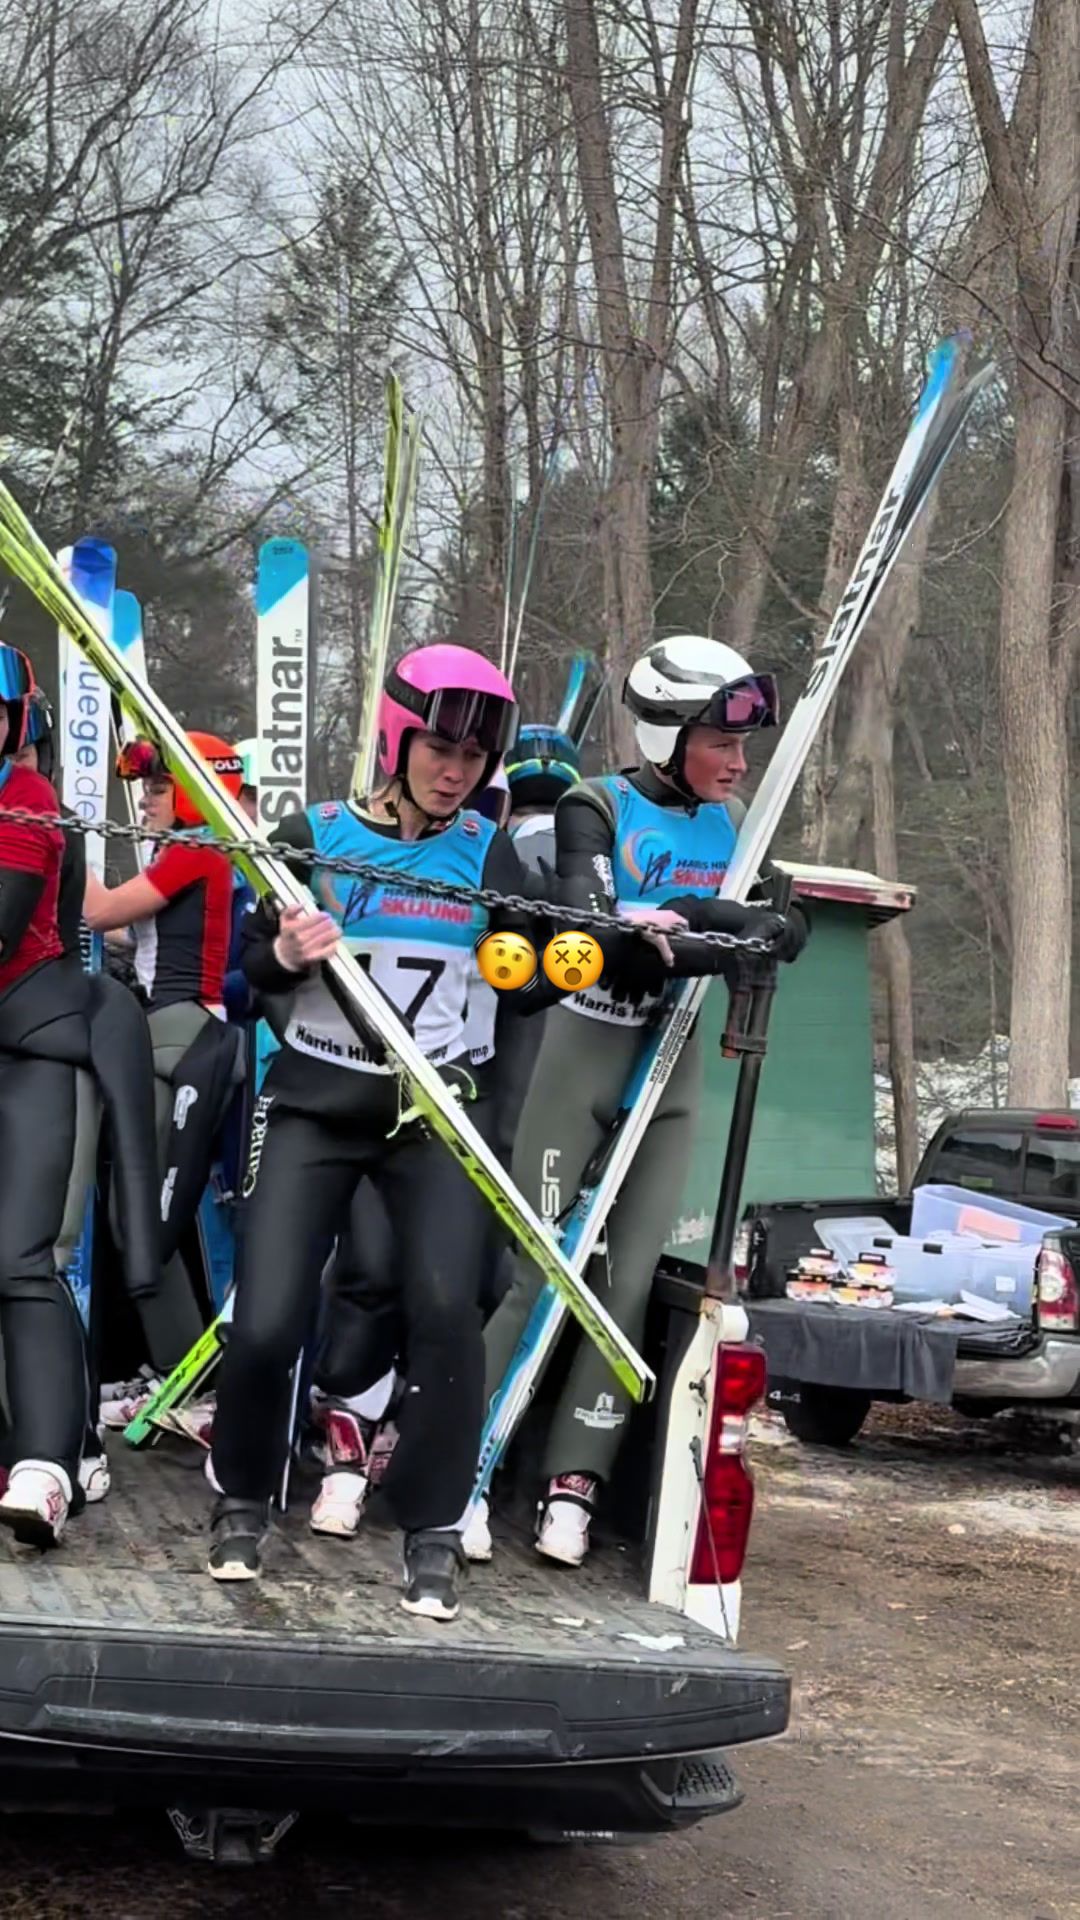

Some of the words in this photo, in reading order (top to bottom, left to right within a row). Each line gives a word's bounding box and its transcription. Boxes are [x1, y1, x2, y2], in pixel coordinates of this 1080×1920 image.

[800, 487, 900, 699] Slatnar
[259, 636, 304, 824] Slatnar
[296, 1023, 342, 1057] Harris
[573, 991, 626, 1018] Harris
[242, 1094, 277, 1198] Canada
